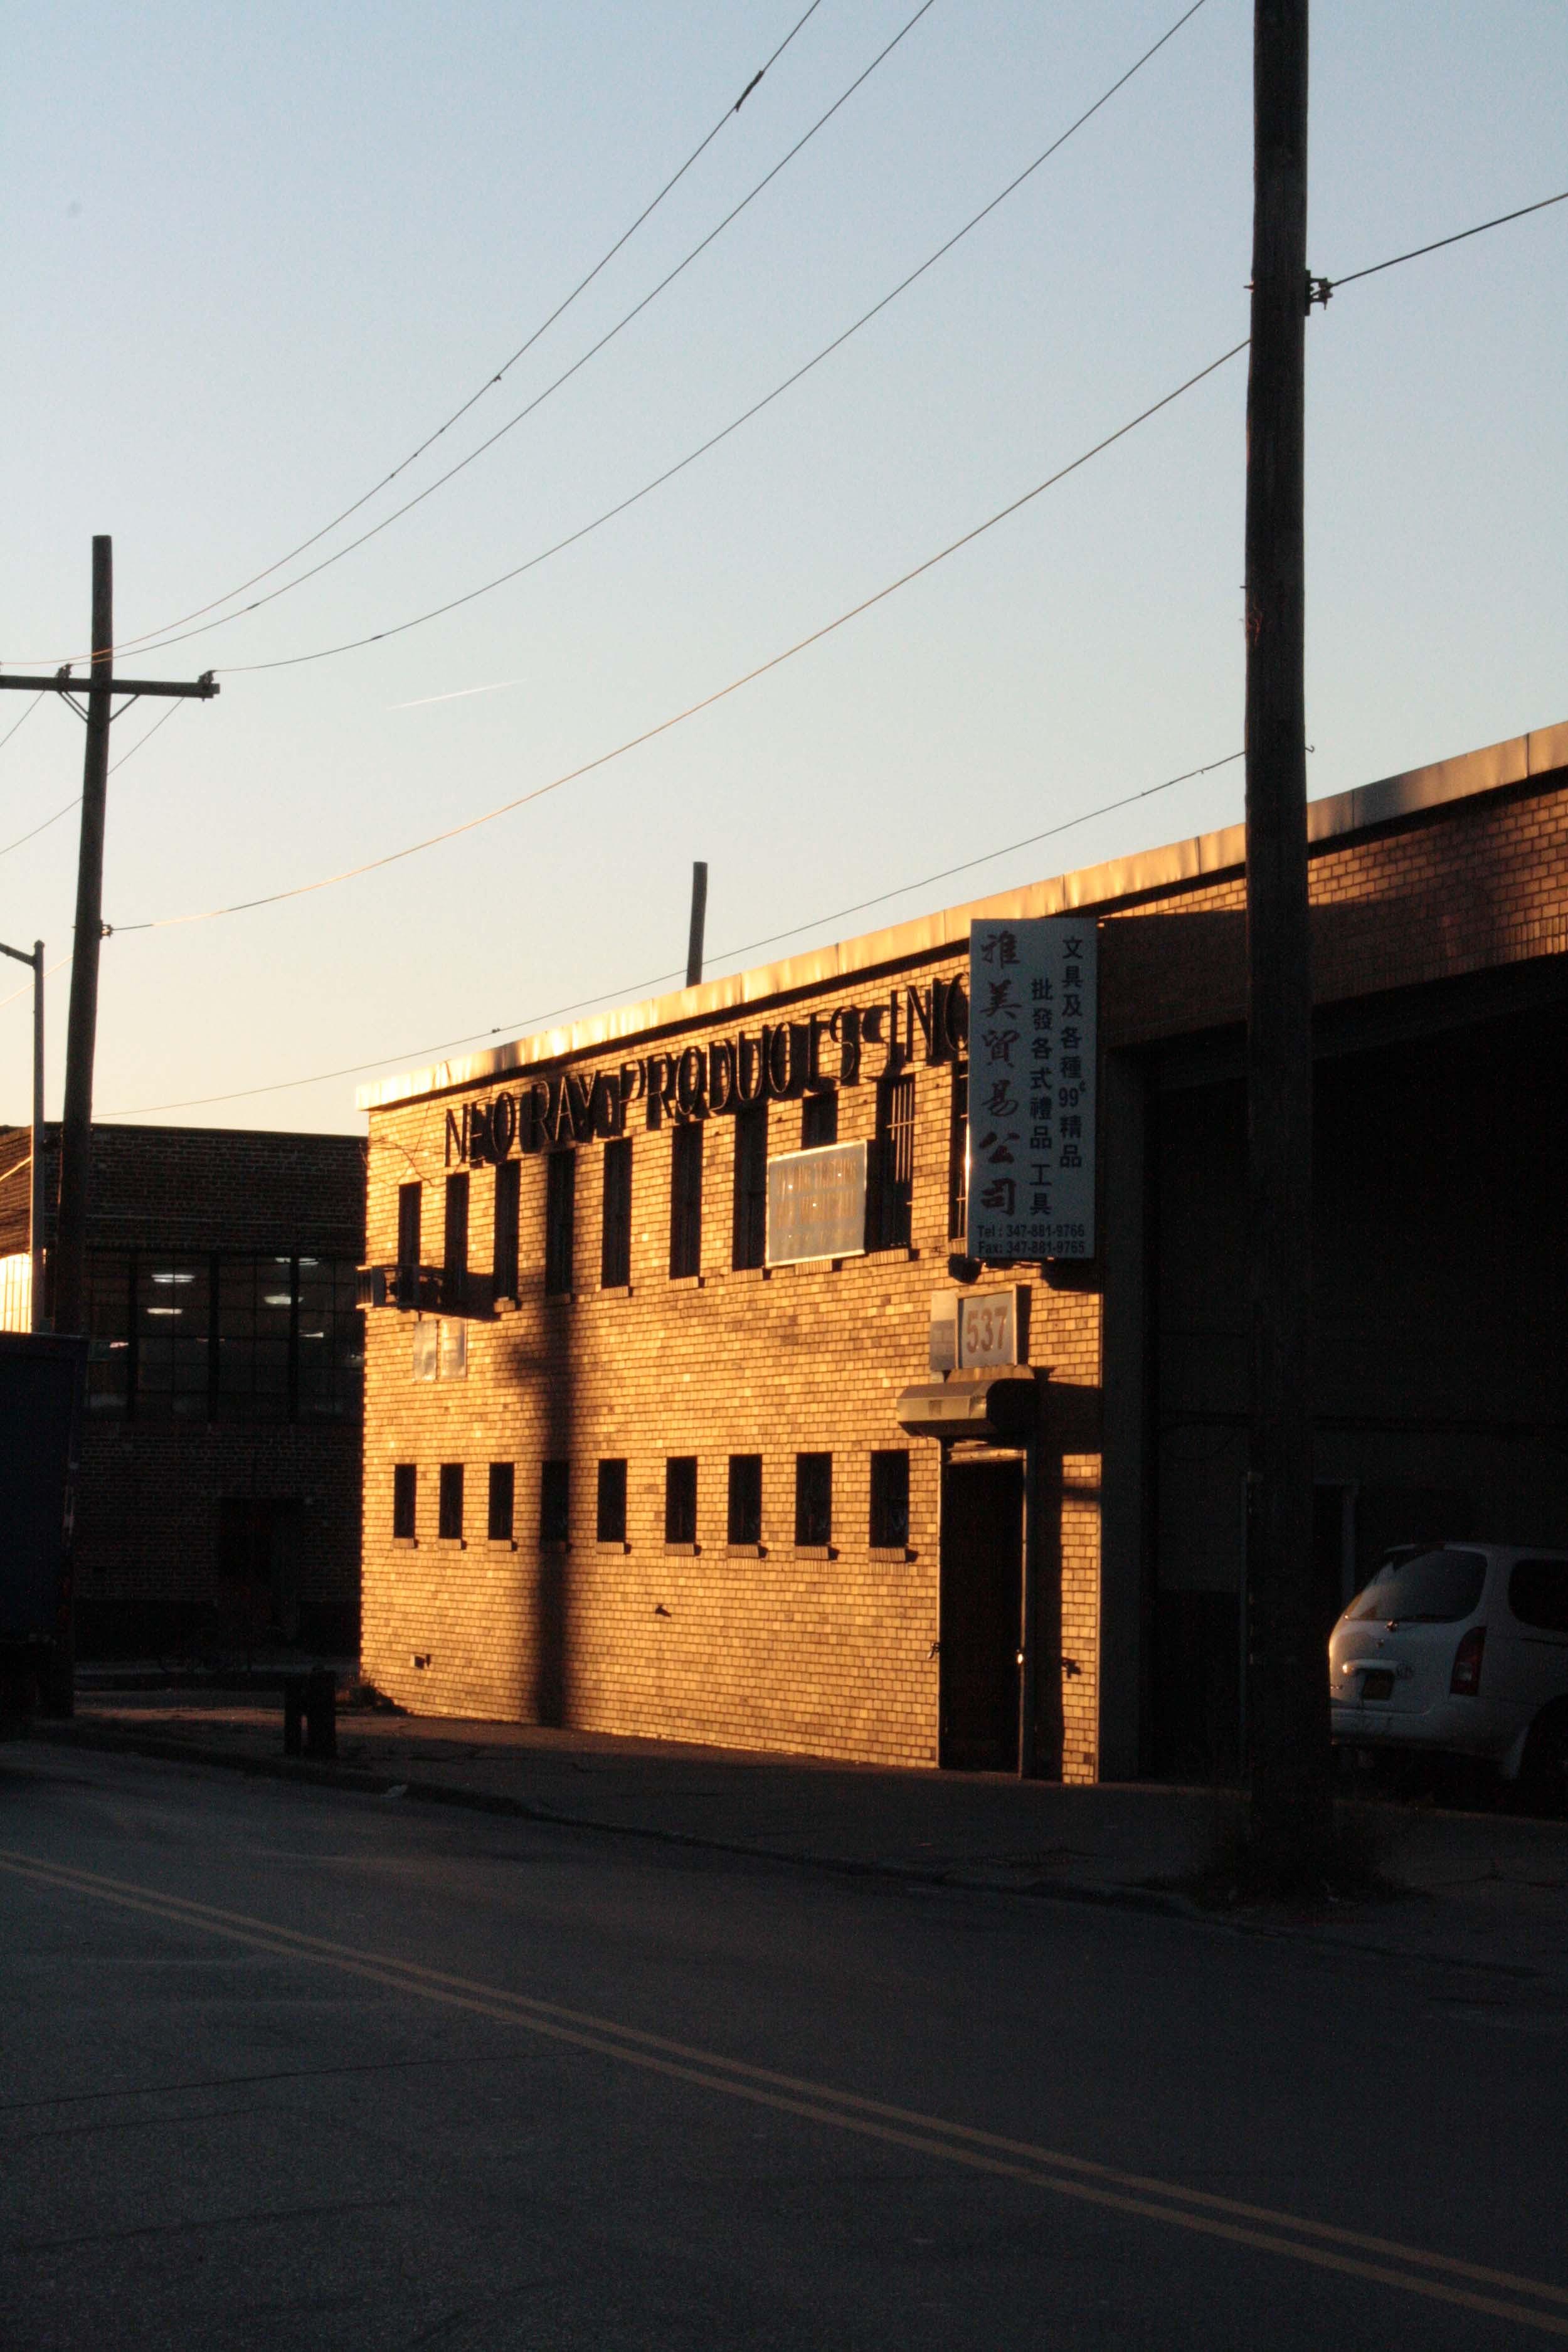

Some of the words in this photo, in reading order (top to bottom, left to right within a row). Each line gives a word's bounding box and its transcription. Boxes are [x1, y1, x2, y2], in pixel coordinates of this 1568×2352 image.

[445, 1091, 516, 1168] NEO
[531, 1069, 600, 1150] RAY
[618, 1005, 859, 1130] PRODUCTS
[966, 1305, 1008, 1353] 537
